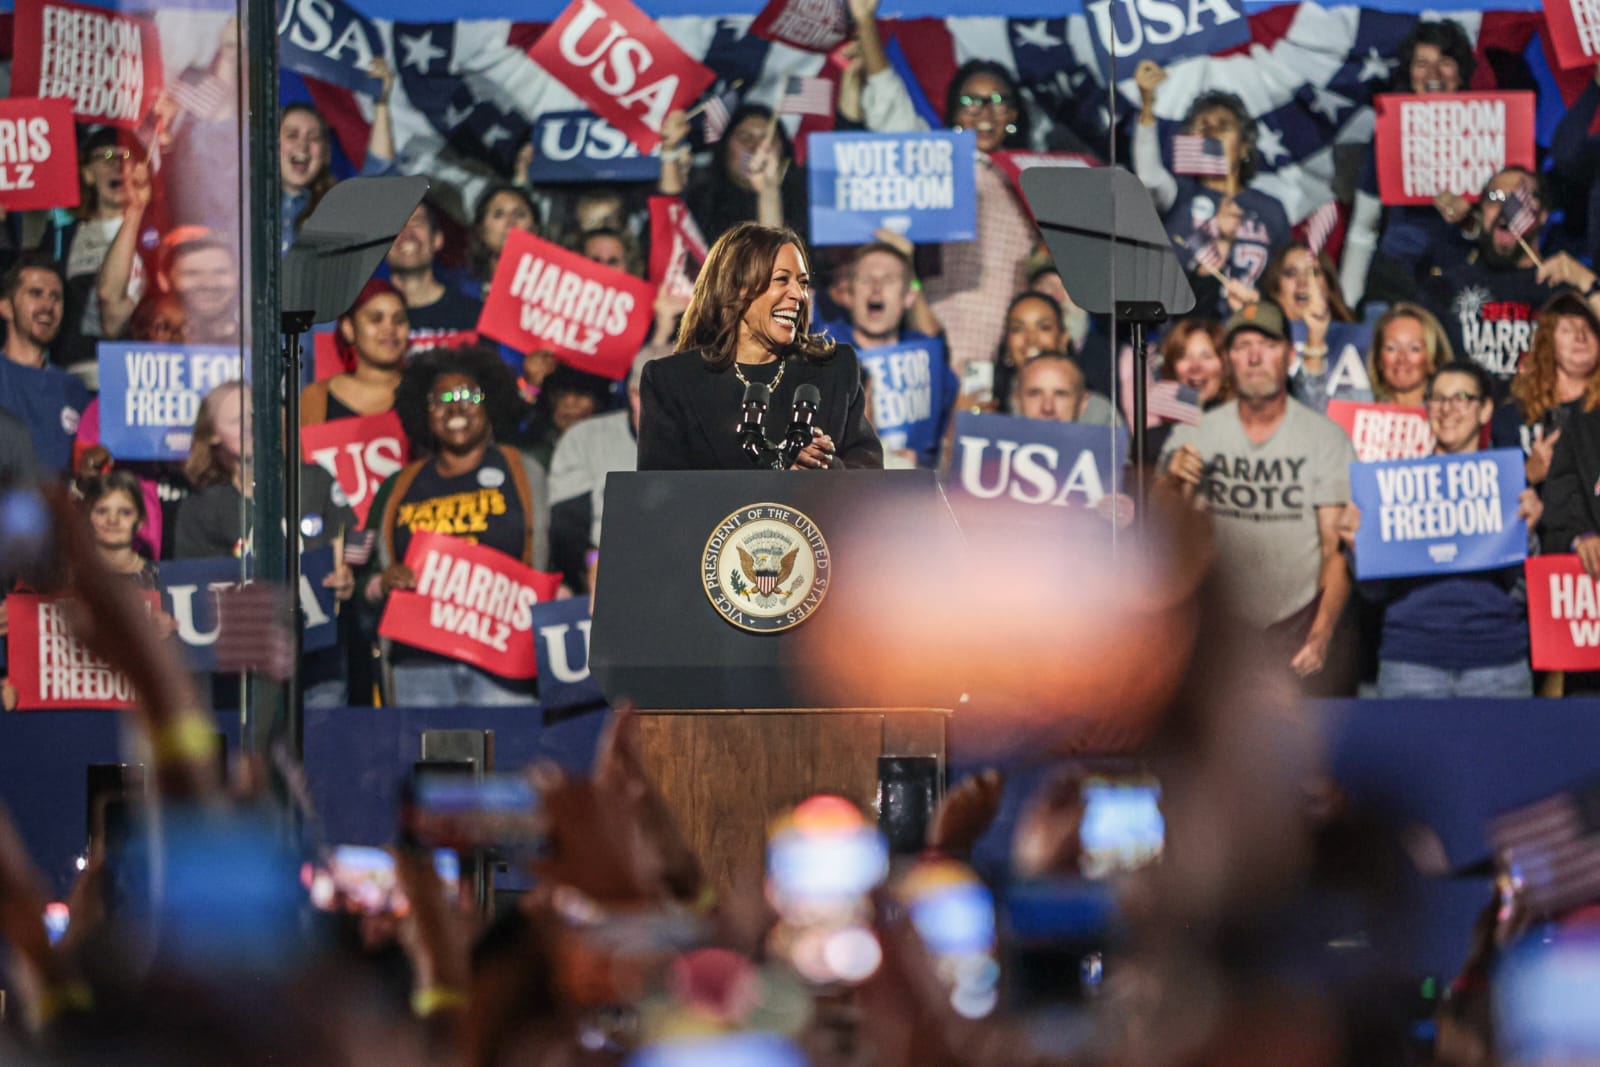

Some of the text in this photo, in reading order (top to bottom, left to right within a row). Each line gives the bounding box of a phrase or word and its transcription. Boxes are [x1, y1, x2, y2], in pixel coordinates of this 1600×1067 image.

[43, 4, 141, 55] FREEDOM
[1087, 0, 1241, 57] USA
[41, 43, 144, 90] FREEDOM
[559, 0, 680, 132] USA
[1401, 99, 1506, 137] FREEDOM
[833, 139, 953, 176] VOTE FOR
[1401, 134, 1506, 168] FREEDOM
[834, 174, 954, 211] FREEDOM
[510, 252, 634, 336] HARRIS
[520, 303, 603, 355] WALZ
[125, 351, 185, 392] VOTE
[889, 348, 931, 389] FOR
[960, 435, 1105, 509] USA
[1205, 453, 1306, 482] ARMY
[1376, 460, 1499, 505] VOTE FOR
[1206, 480, 1304, 510] ROTC
[1379, 498, 1503, 542] FREEDOM
[705, 508, 828, 624] VICE PRESIDENT OF THE UNITED STATES
[416, 550, 538, 632] HARRIS
[1549, 573, 1600, 619] HA
[430, 601, 511, 652] WALZ
[39, 666, 136, 702] FREEDO
